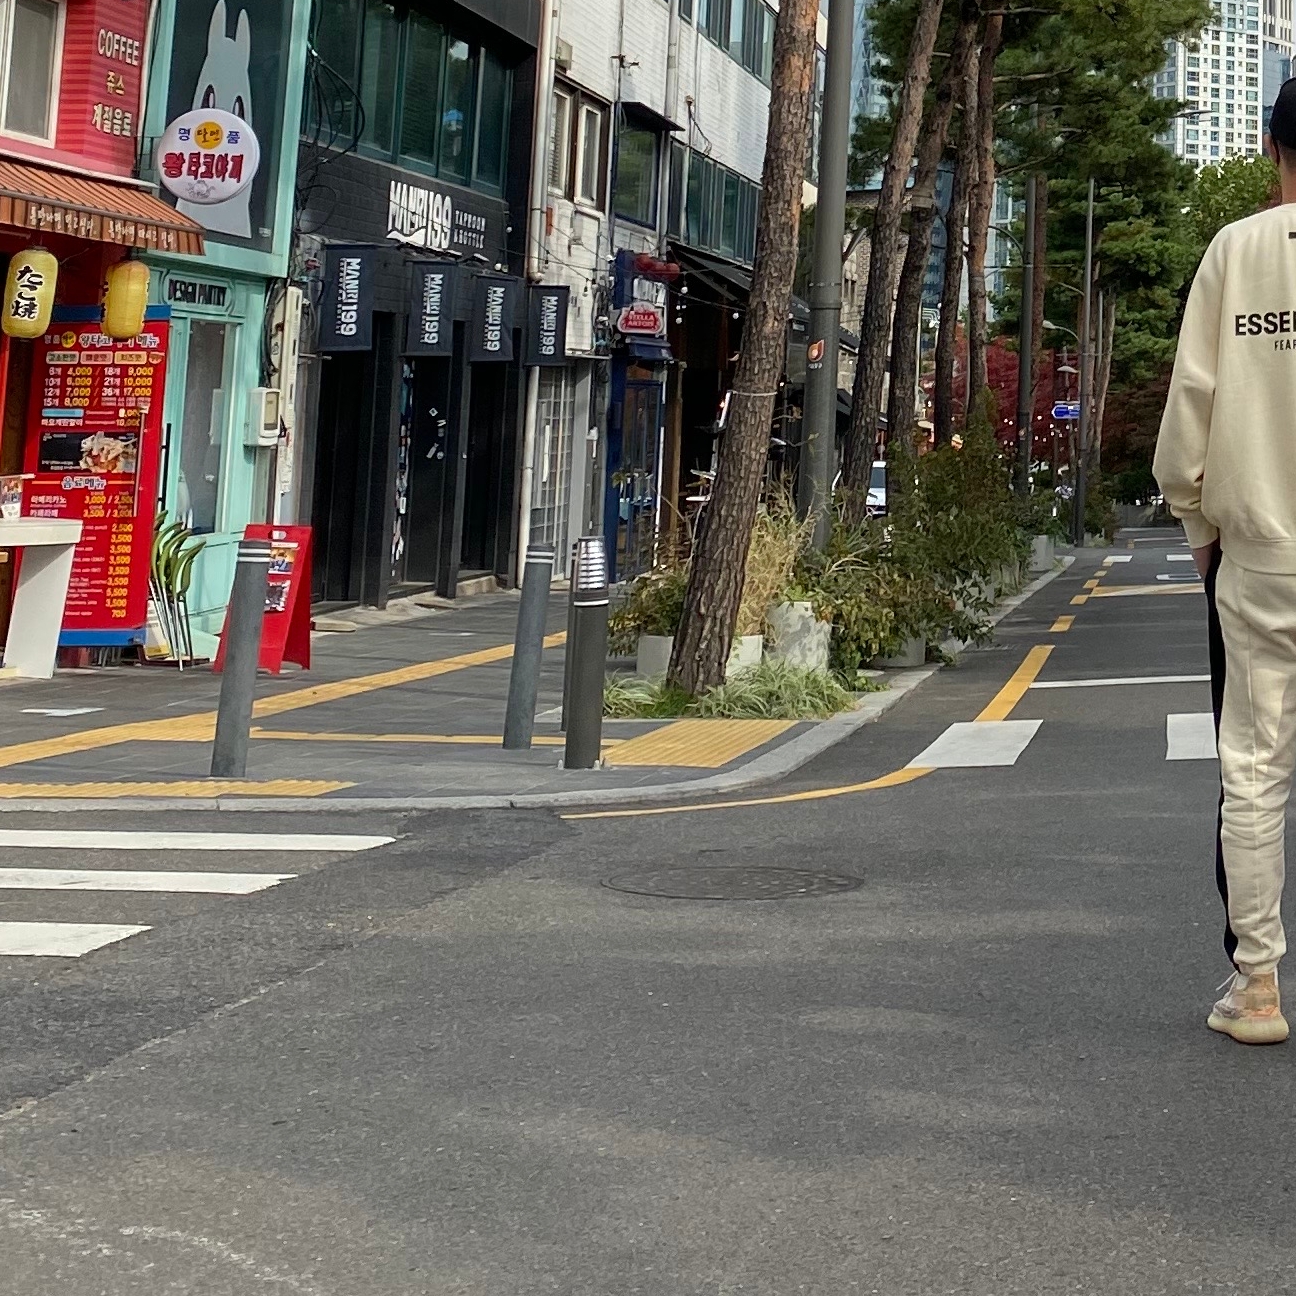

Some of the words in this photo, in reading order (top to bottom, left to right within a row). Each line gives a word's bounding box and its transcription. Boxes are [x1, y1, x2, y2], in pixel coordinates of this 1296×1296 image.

[98, 28, 140, 67] COFFEE
[106, 70, 125, 95] 쥬스
[92, 103, 132, 137] 계절음료
[11, 266, 44, 321] たこ焼
